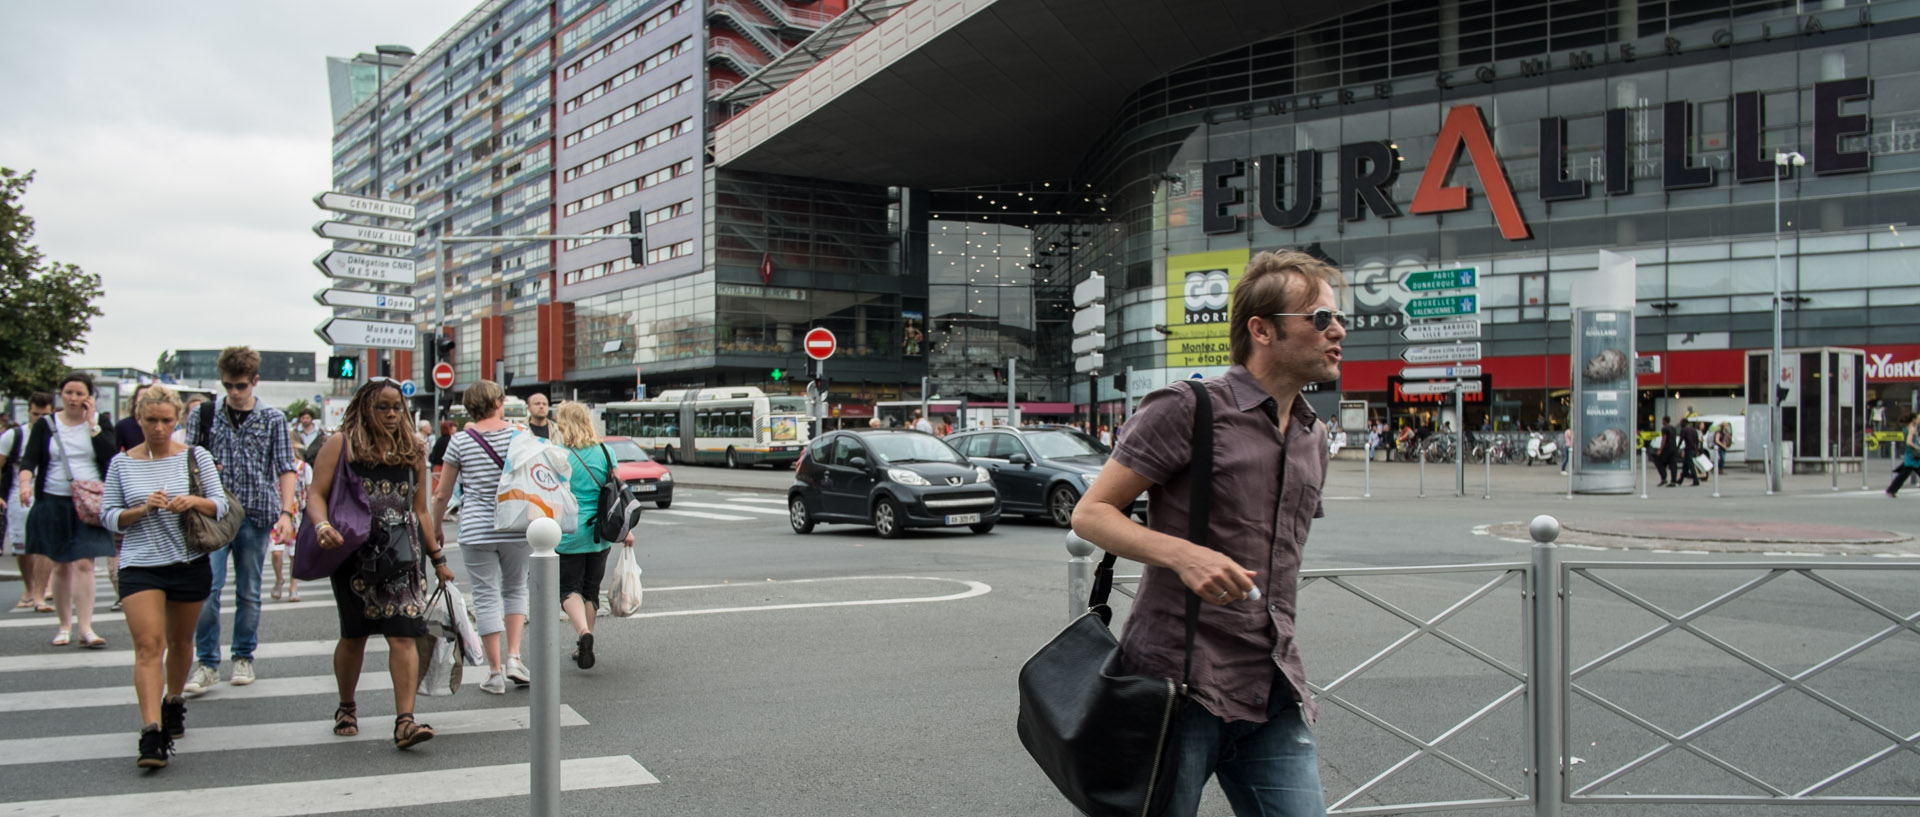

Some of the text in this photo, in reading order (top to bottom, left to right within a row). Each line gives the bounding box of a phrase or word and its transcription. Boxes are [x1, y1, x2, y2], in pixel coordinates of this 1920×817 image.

[1203, 8, 1873, 125] CENTRE COMMERCIAL
[1202, 76, 1871, 241] EURALILLE
[350, 199, 413, 216] CENTRE VILLE
[358, 229, 413, 244] VIEUX LILLE
[347, 255, 413, 271] Délégation CNRS
[1433, 271, 1455, 280] PARIS
[1412, 280, 1455, 290] DUNKERQUE
[1184, 272, 1229, 310] GO
[387, 298, 413, 309] Opéra
[1412, 298, 1456, 307] BRUXELLES
[1413, 306, 1456, 316] VALENCIENNES
[1185, 312, 1228, 324] SPORT
[366, 324, 413, 335] Musée des
[365, 335, 414, 346] Canonniers
[1182, 342, 1215, 353] Montez
